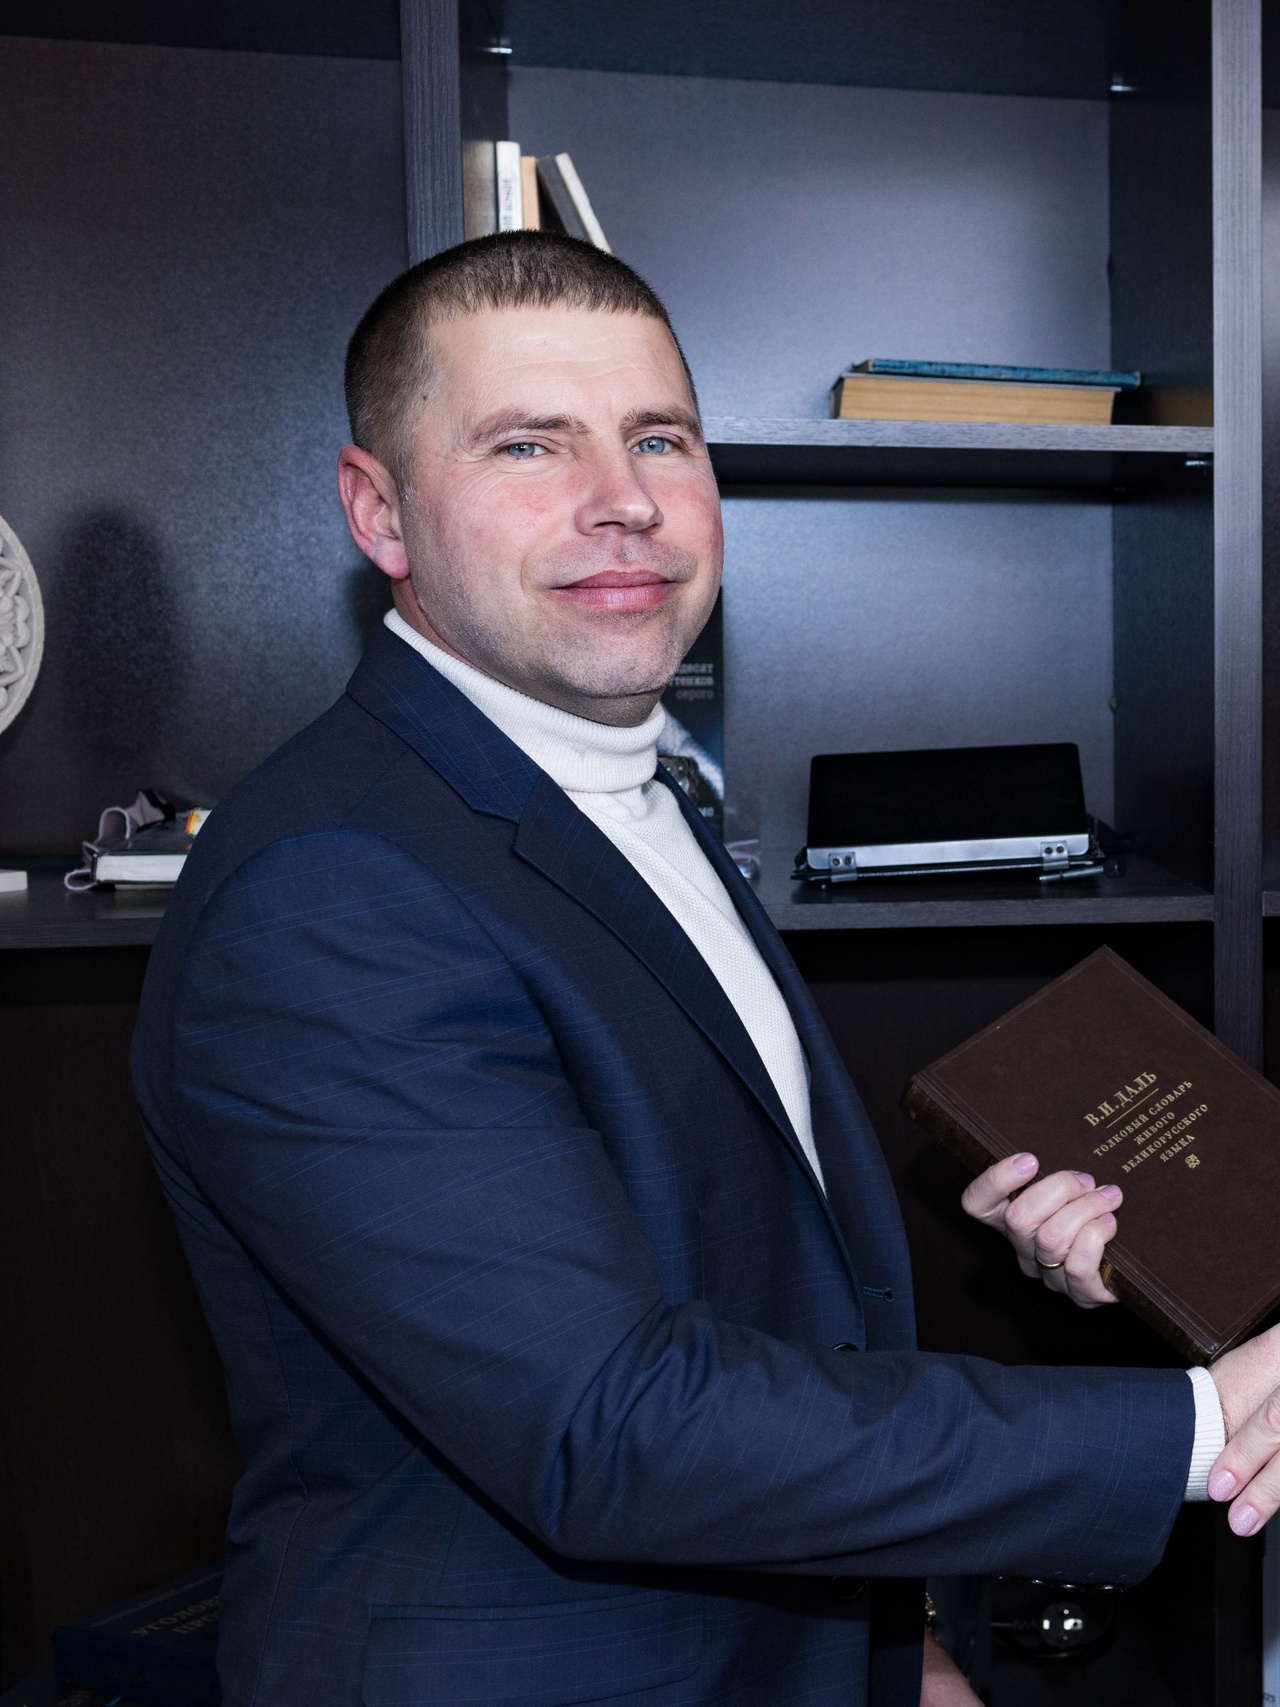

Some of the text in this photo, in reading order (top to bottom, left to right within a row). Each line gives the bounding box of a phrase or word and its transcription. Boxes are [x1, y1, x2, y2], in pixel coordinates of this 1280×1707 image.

[1093, 1080, 1193, 1157] ТОЛКОВЫЙ СЛОВАРЬ
[1121, 1103, 1209, 1173] ВЕЛИКОРУССКОГО
[1133, 1111, 1175, 1145] ЖИВОГО
[1160, 1133, 1196, 1163] ЯЗЫКА
